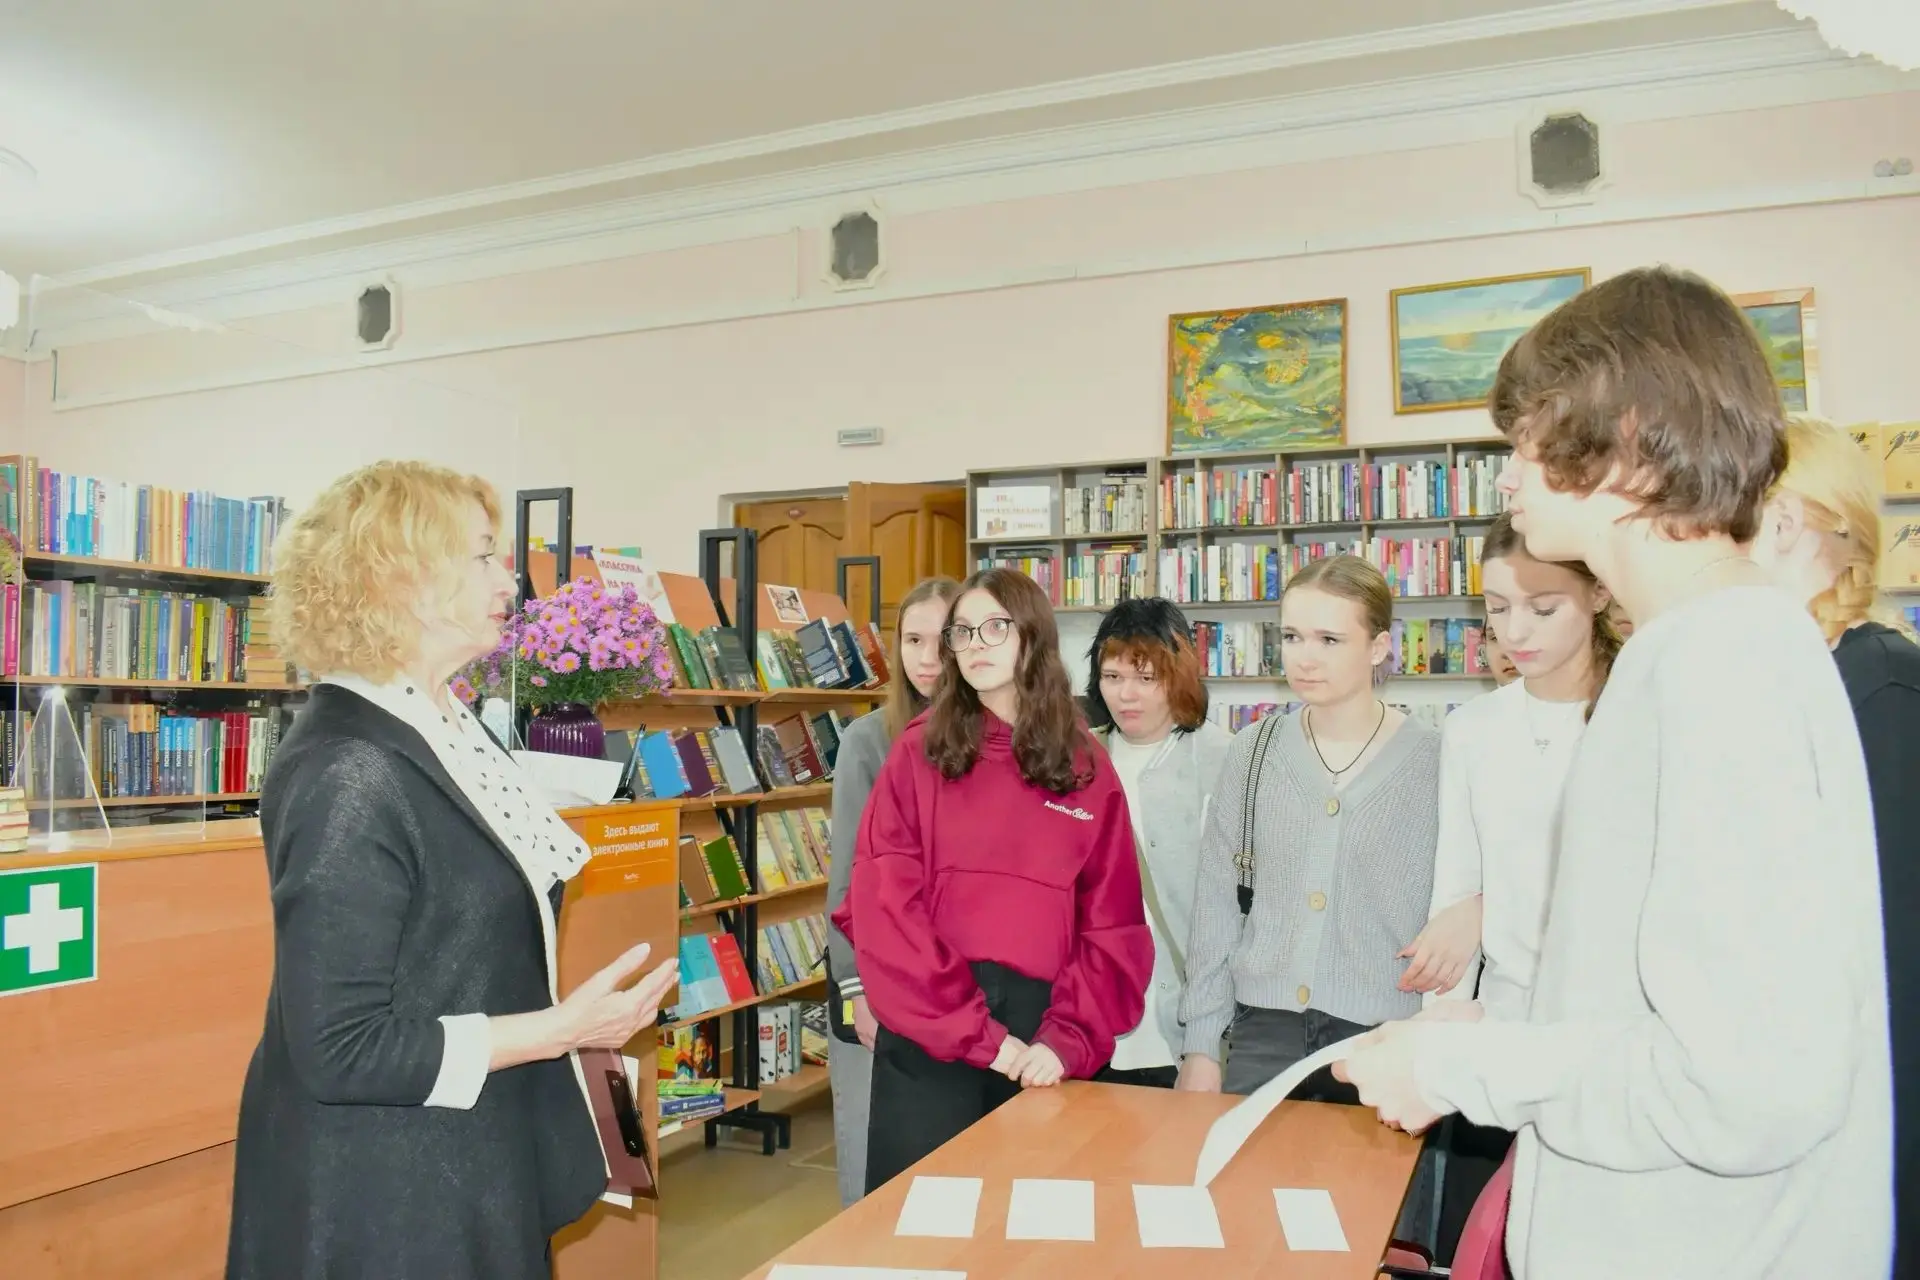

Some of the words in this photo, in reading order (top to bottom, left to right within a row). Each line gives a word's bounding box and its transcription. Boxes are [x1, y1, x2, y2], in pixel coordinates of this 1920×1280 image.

[604, 825, 628, 839] Здесь
[629, 822, 660, 835] выдают
[593, 842, 646, 856] электронные
[647, 838, 669, 849] книги
